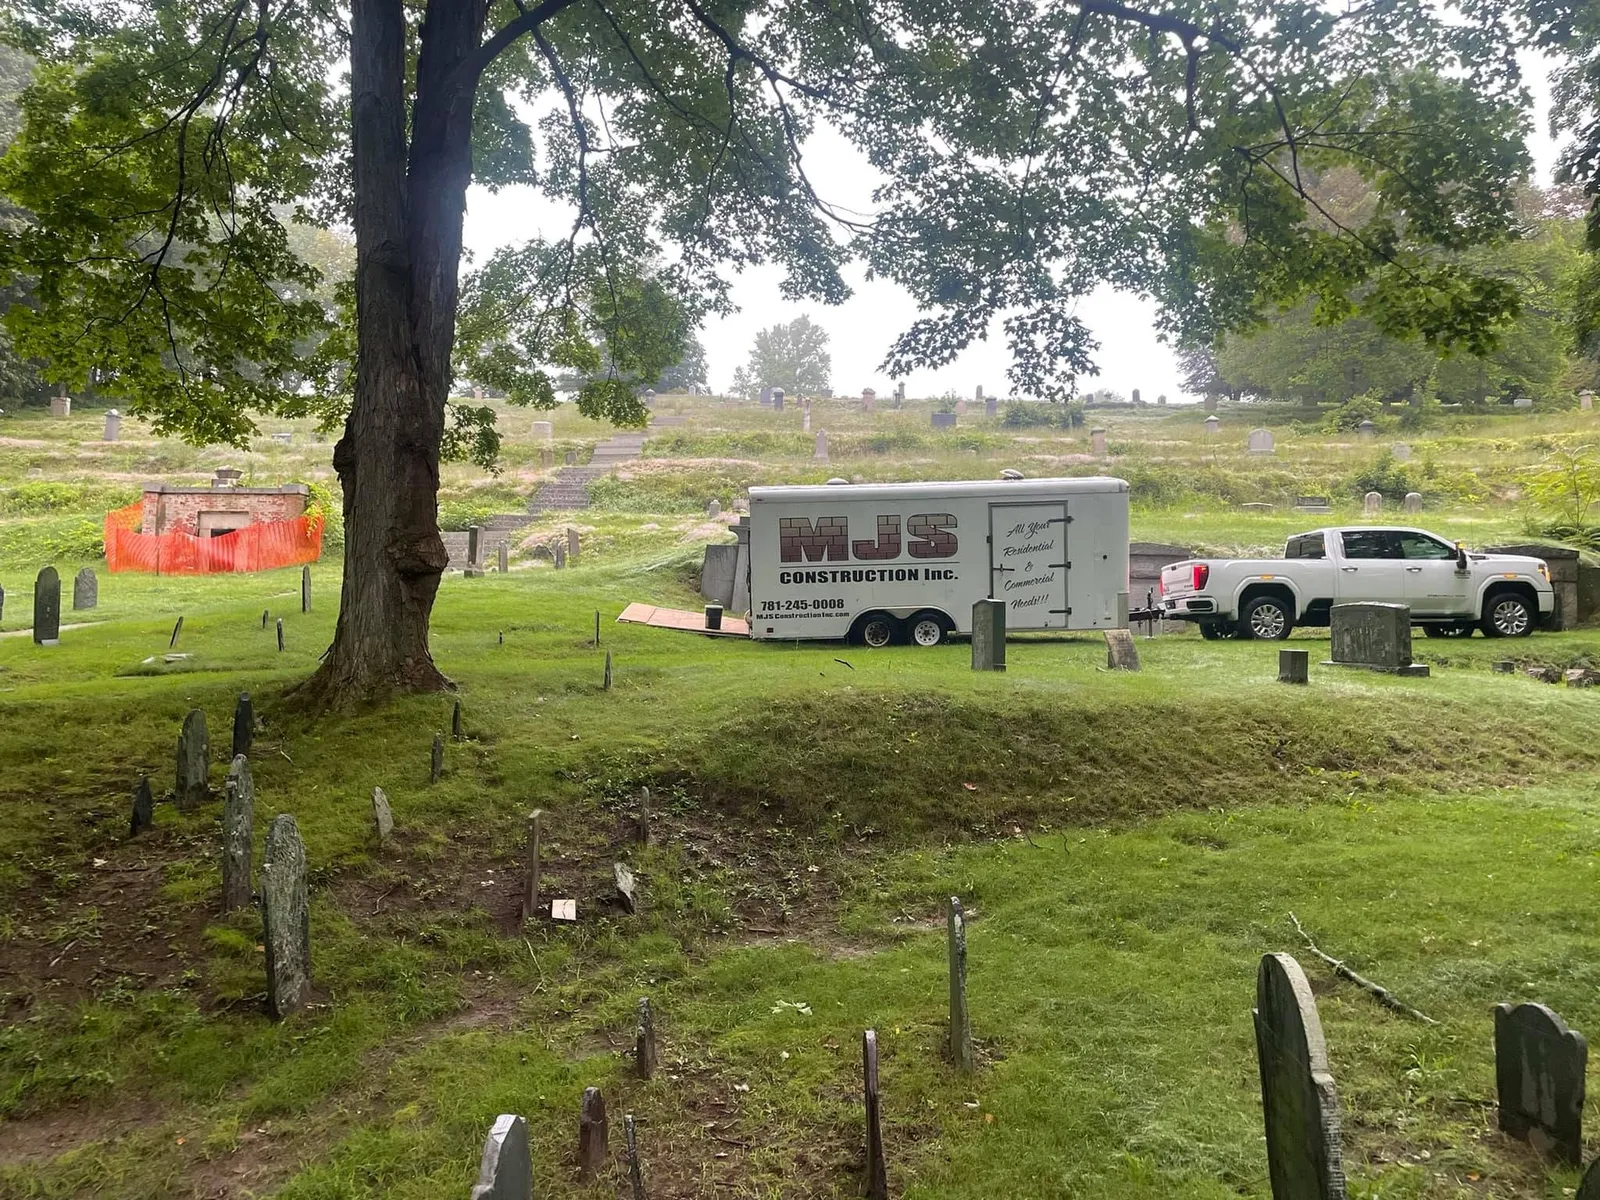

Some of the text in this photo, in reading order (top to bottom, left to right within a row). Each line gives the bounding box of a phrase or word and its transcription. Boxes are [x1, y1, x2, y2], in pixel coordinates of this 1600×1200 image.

[779, 513, 958, 563] MJS
[1006, 521, 1050, 540] All Your
[1003, 539, 1054, 557] Residential
[1024, 561, 1034, 572] &
[779, 568, 959, 584] CONSTRUCTION Inc.
[1004, 571, 1055, 592] Commercial
[760, 598, 844, 611] 781-245-0008
[1010, 593, 1049, 610] Needs!!!
